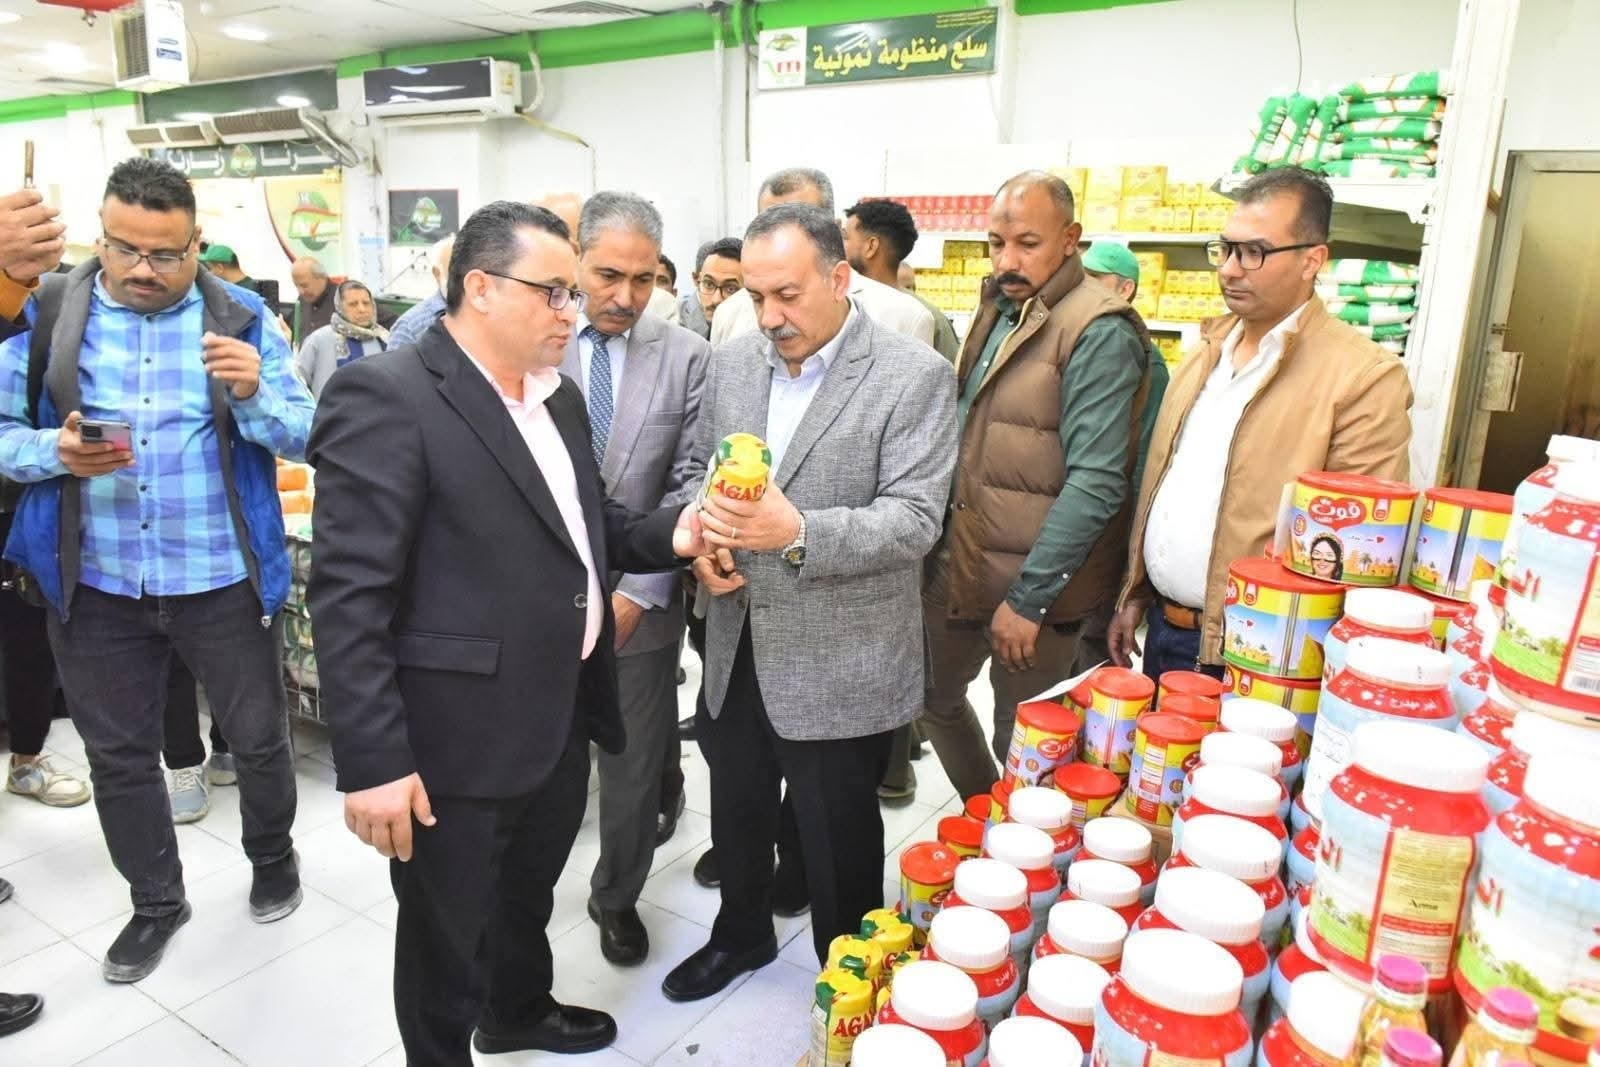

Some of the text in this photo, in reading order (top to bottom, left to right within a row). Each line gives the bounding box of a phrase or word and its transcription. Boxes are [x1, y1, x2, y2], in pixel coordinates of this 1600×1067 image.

[877, 37, 948, 70] منظومة
[950, 35, 988, 70] سلع
[1311, 498, 1361, 521] قوت
